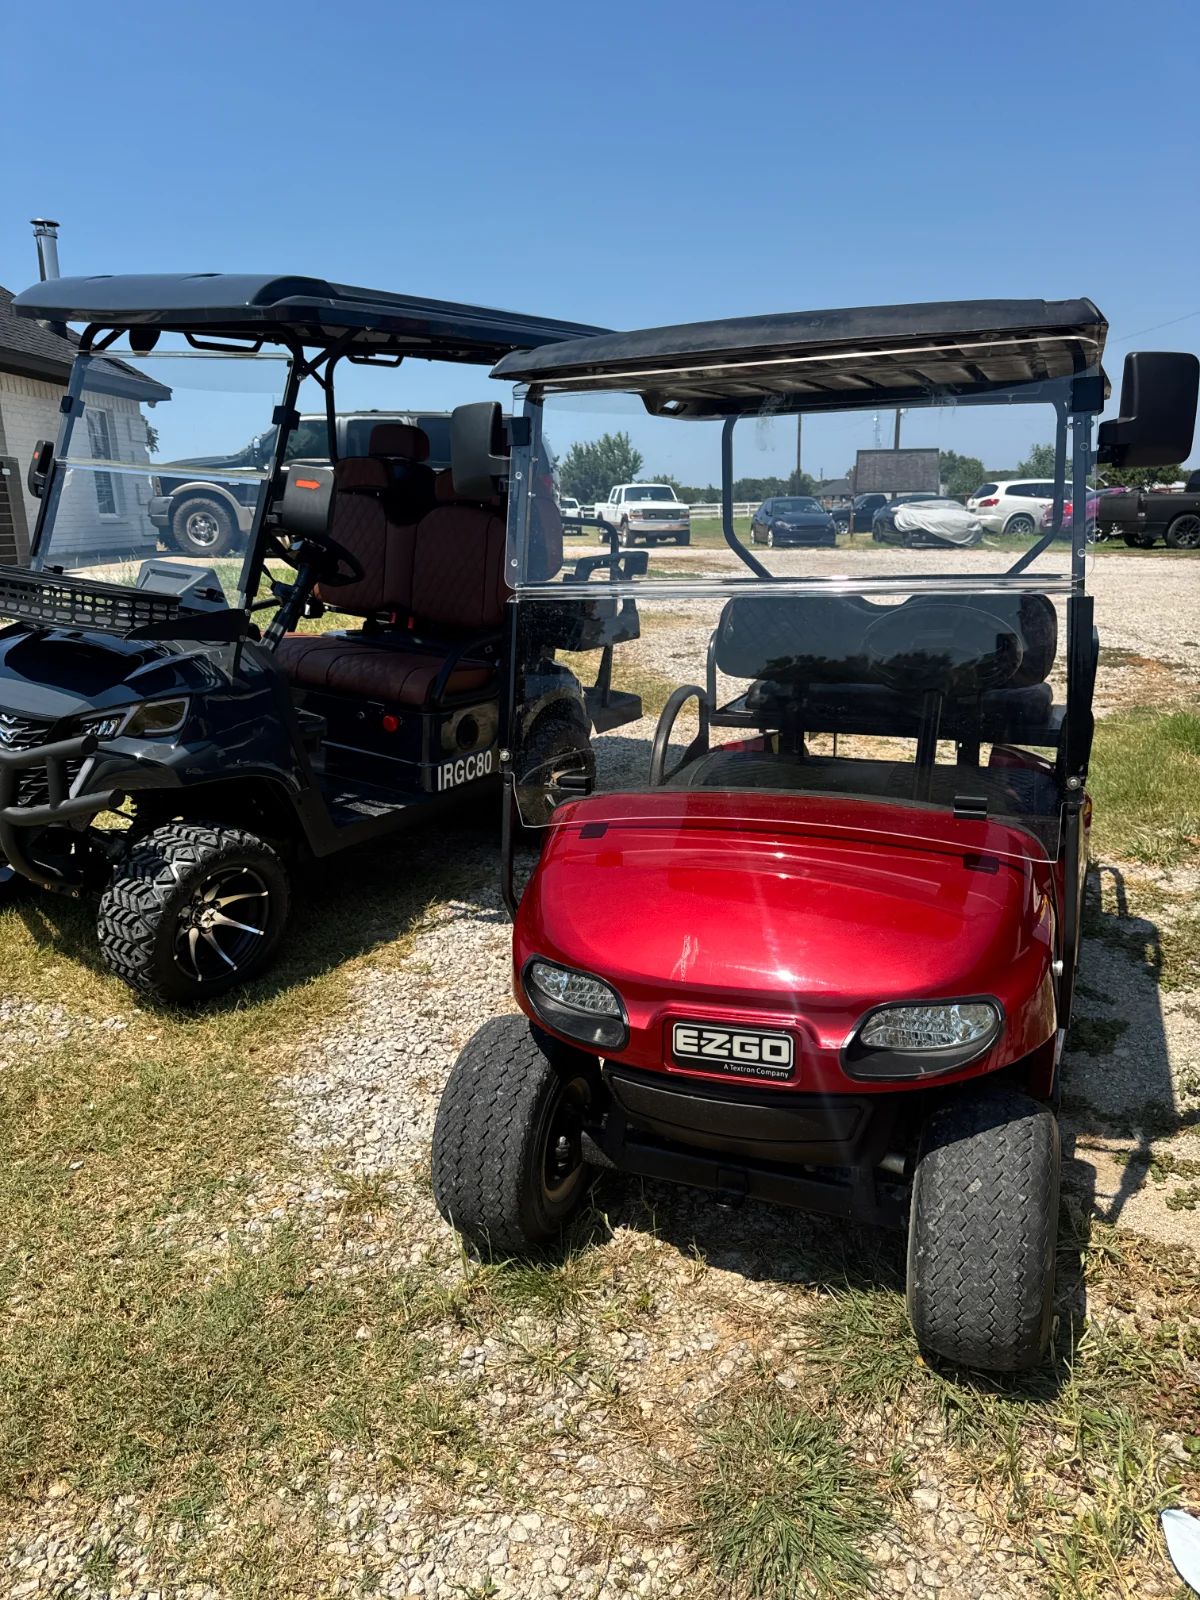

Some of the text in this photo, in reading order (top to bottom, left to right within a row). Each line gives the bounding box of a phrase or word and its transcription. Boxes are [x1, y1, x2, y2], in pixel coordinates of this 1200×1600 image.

[437, 750, 492, 792] IRGC80
[730, 1065, 756, 1073] Textron
[756, 1067, 789, 1079] Company
